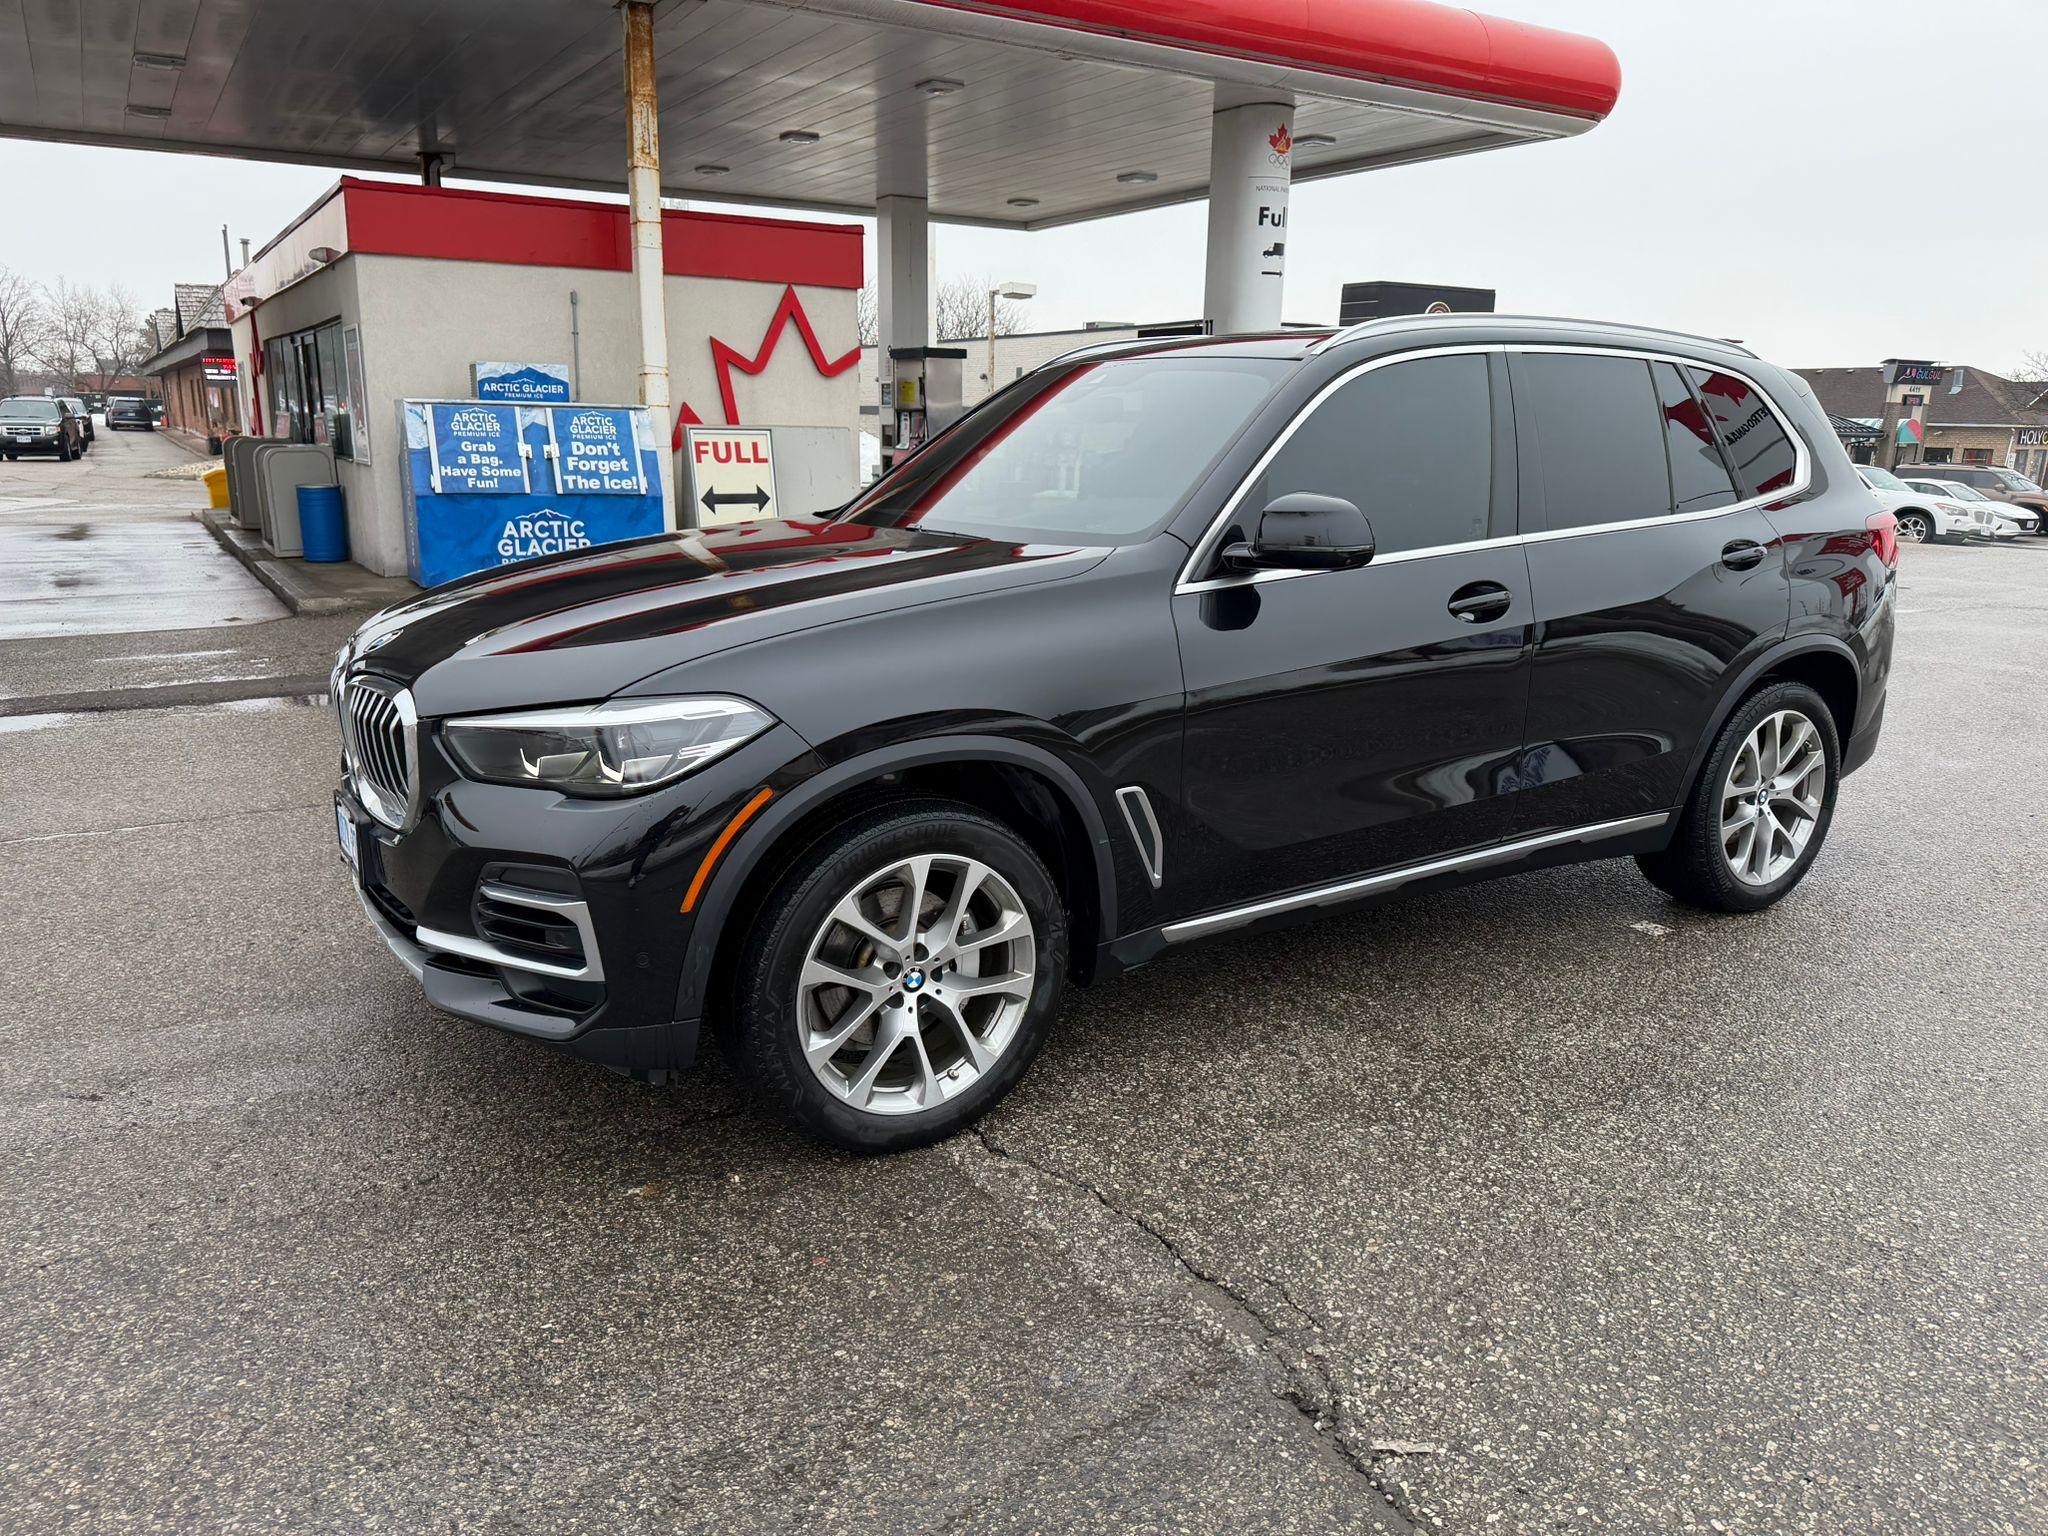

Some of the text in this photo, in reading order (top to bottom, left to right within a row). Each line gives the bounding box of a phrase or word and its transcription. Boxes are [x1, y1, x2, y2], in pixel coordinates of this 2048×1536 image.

[483, 383, 564, 394] ARCTIC GLACIER
[453, 412, 497, 422] ARCTIC
[572, 416, 613, 426] ARCTIC
[451, 421, 501, 431] GLACIER
[569, 424, 617, 434] GLACIER
[461, 441, 496, 452] Grab
[571, 441, 621, 456] Don't
[694, 441, 768, 463] FULL
[457, 453, 503, 467] a Bag.
[567, 457, 629, 474] Forget
[440, 466, 521, 477] Have Some
[467, 478, 498, 488] Fun!
[563, 475, 638, 490] The Ice!
[502, 520, 586, 538] ARCTIC
[497, 538, 591, 556] GLACIER
